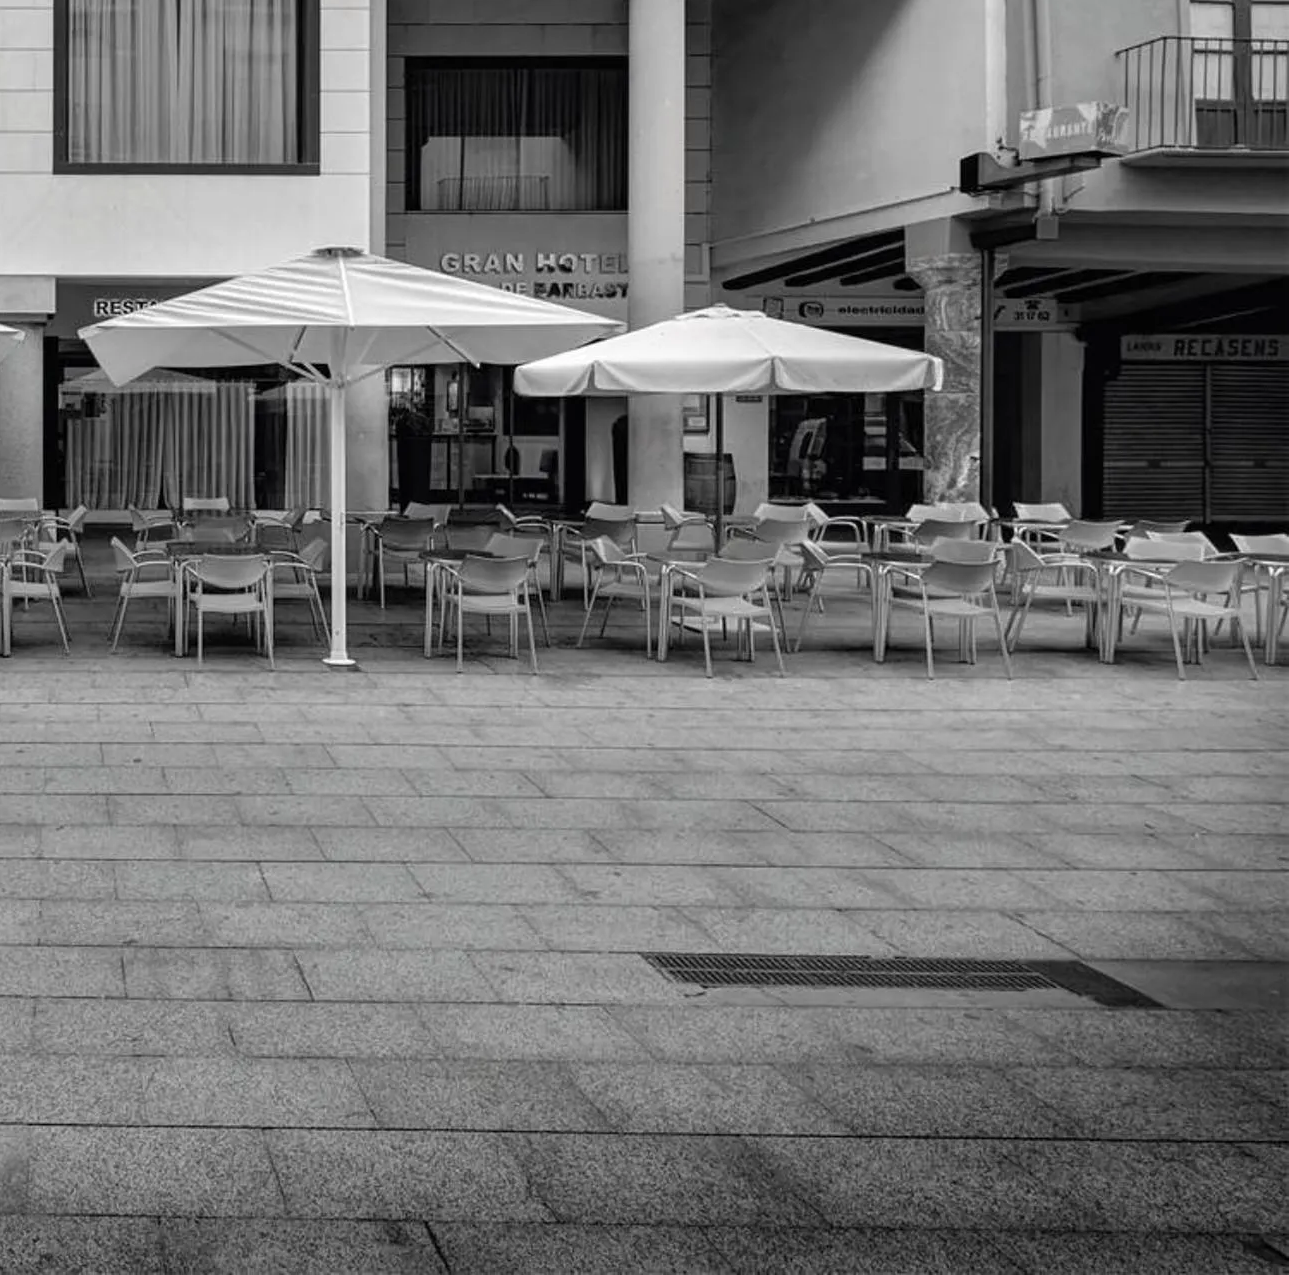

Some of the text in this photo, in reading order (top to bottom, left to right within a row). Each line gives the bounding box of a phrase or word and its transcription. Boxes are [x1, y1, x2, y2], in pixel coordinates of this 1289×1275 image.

[440, 252, 629, 274] GRAN HOTEL
[1173, 338, 1280, 357] RECASENS
